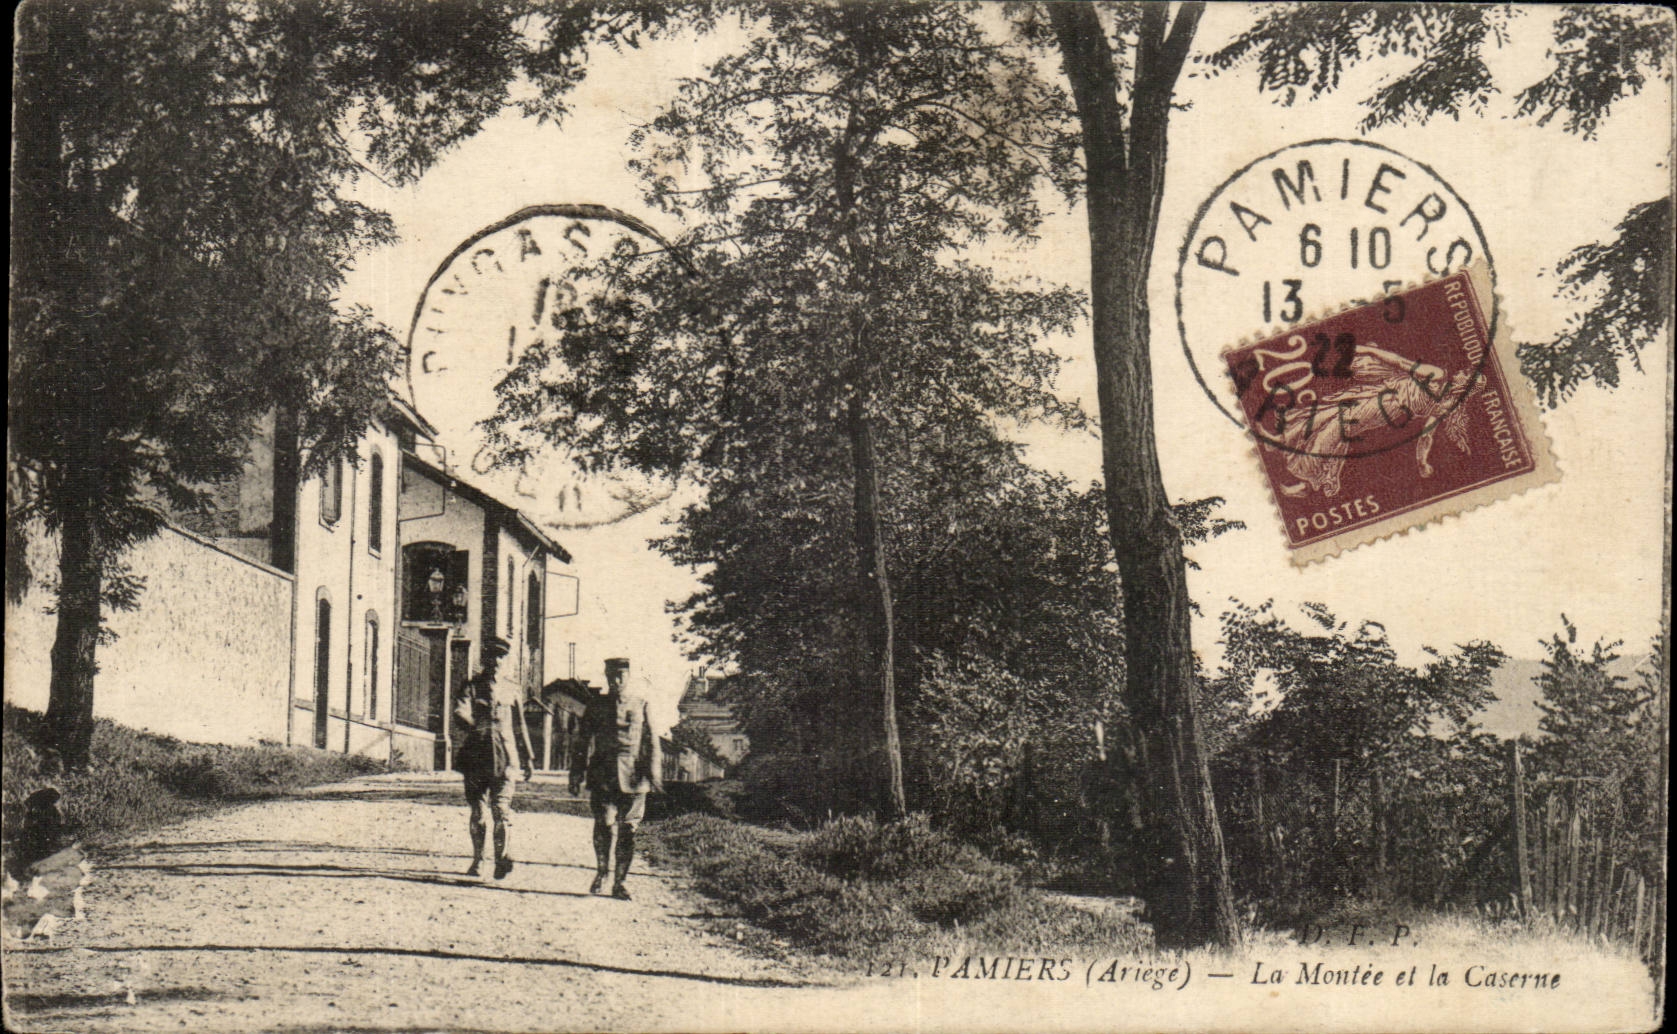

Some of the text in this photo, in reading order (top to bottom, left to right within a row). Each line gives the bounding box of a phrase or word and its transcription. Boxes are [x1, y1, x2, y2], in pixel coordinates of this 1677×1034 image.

[1196, 158, 1473, 277] PAMIERS
[1300, 222, 1392, 269] 6 10
[1262, 279, 1304, 323] 13
[1444, 281, 1485, 367] REPUBLIQU
[1311, 332, 1357, 379] 22
[1296, 495, 1380, 536] POSTES
